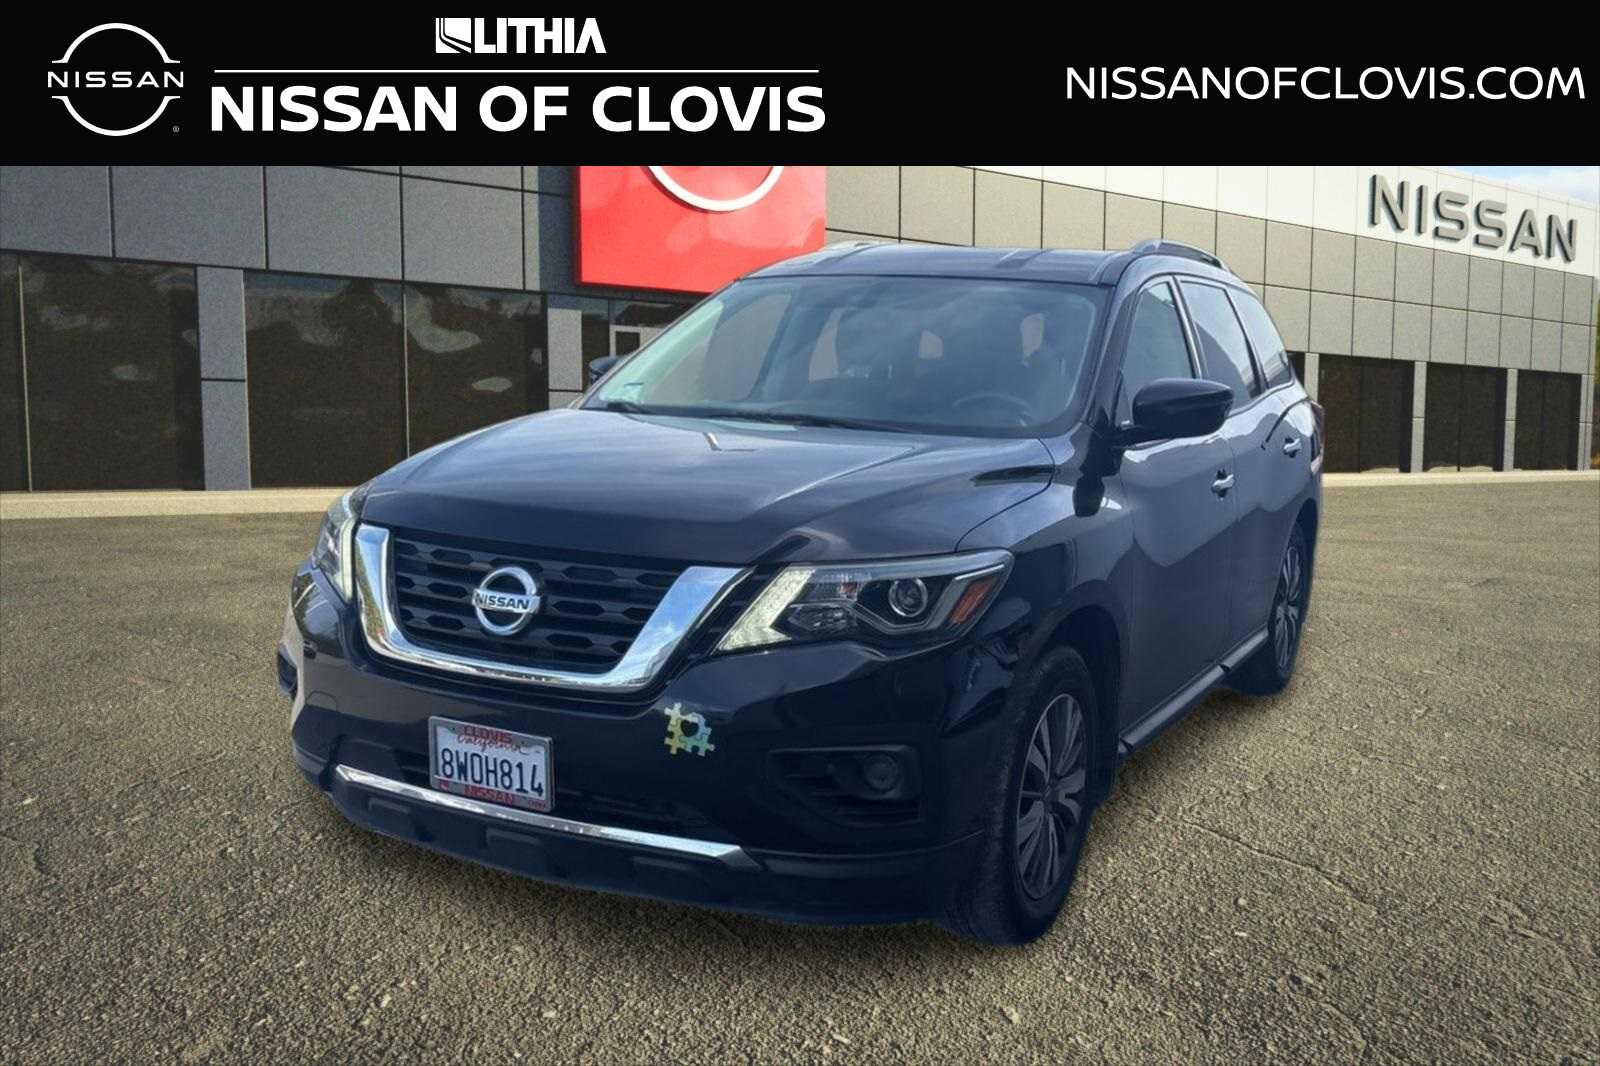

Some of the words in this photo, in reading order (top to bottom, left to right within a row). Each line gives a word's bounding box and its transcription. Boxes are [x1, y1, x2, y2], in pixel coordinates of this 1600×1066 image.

[1369, 174, 1578, 263] NISSAN
[474, 591, 530, 610] NISSAN
[463, 783, 514, 806] NISSAN
